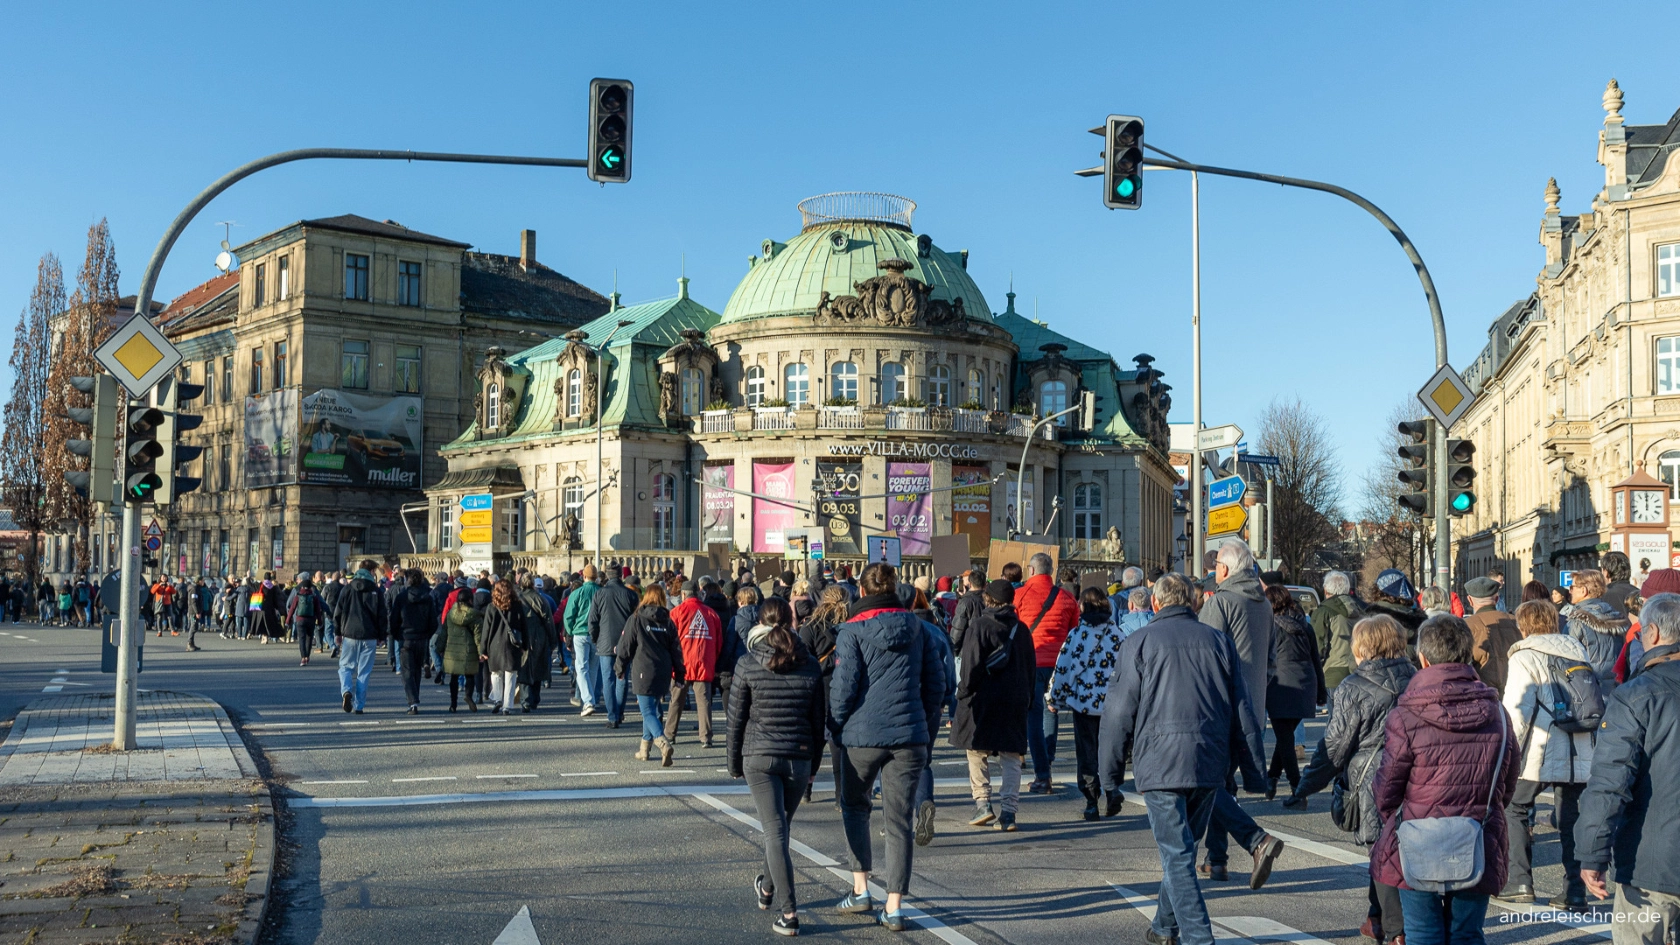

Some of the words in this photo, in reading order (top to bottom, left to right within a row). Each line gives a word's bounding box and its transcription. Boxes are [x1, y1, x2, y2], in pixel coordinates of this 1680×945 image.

[329, 404, 353, 414] KAROQ
[827, 441, 978, 459] www.VILLA-MOCC.de
[837, 473, 860, 491] 30
[888, 476, 930, 485] FOREVER
[889, 484, 930, 493] YOUNG
[705, 491, 735, 499] FRAUENTAG
[1212, 489, 1227, 500] Chemnitz
[706, 501, 733, 510] 08.03.24
[822, 502, 858, 515] 09.03.
[953, 503, 990, 513] 10.02.
[831, 520, 848, 530] Ü30
[892, 514, 928, 527] 03.02.
